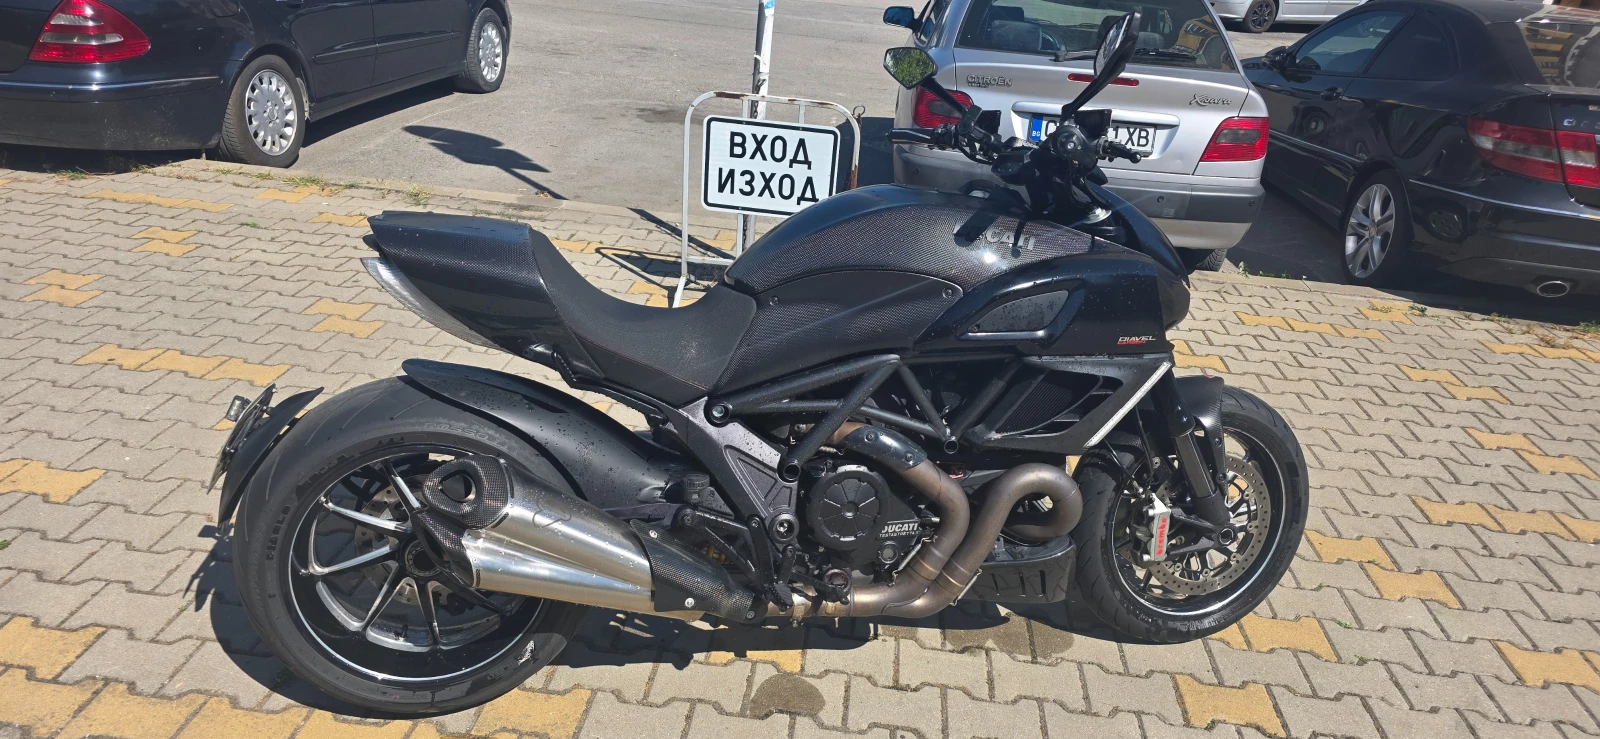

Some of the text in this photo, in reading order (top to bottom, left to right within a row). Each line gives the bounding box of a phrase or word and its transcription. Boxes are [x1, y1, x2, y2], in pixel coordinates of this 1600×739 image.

[967, 74, 1012, 87] CITROËN
[729, 131, 812, 170] ВХОД
[717, 167, 819, 205] ИЗХОД
[1155, 516, 1167, 556] brembo
